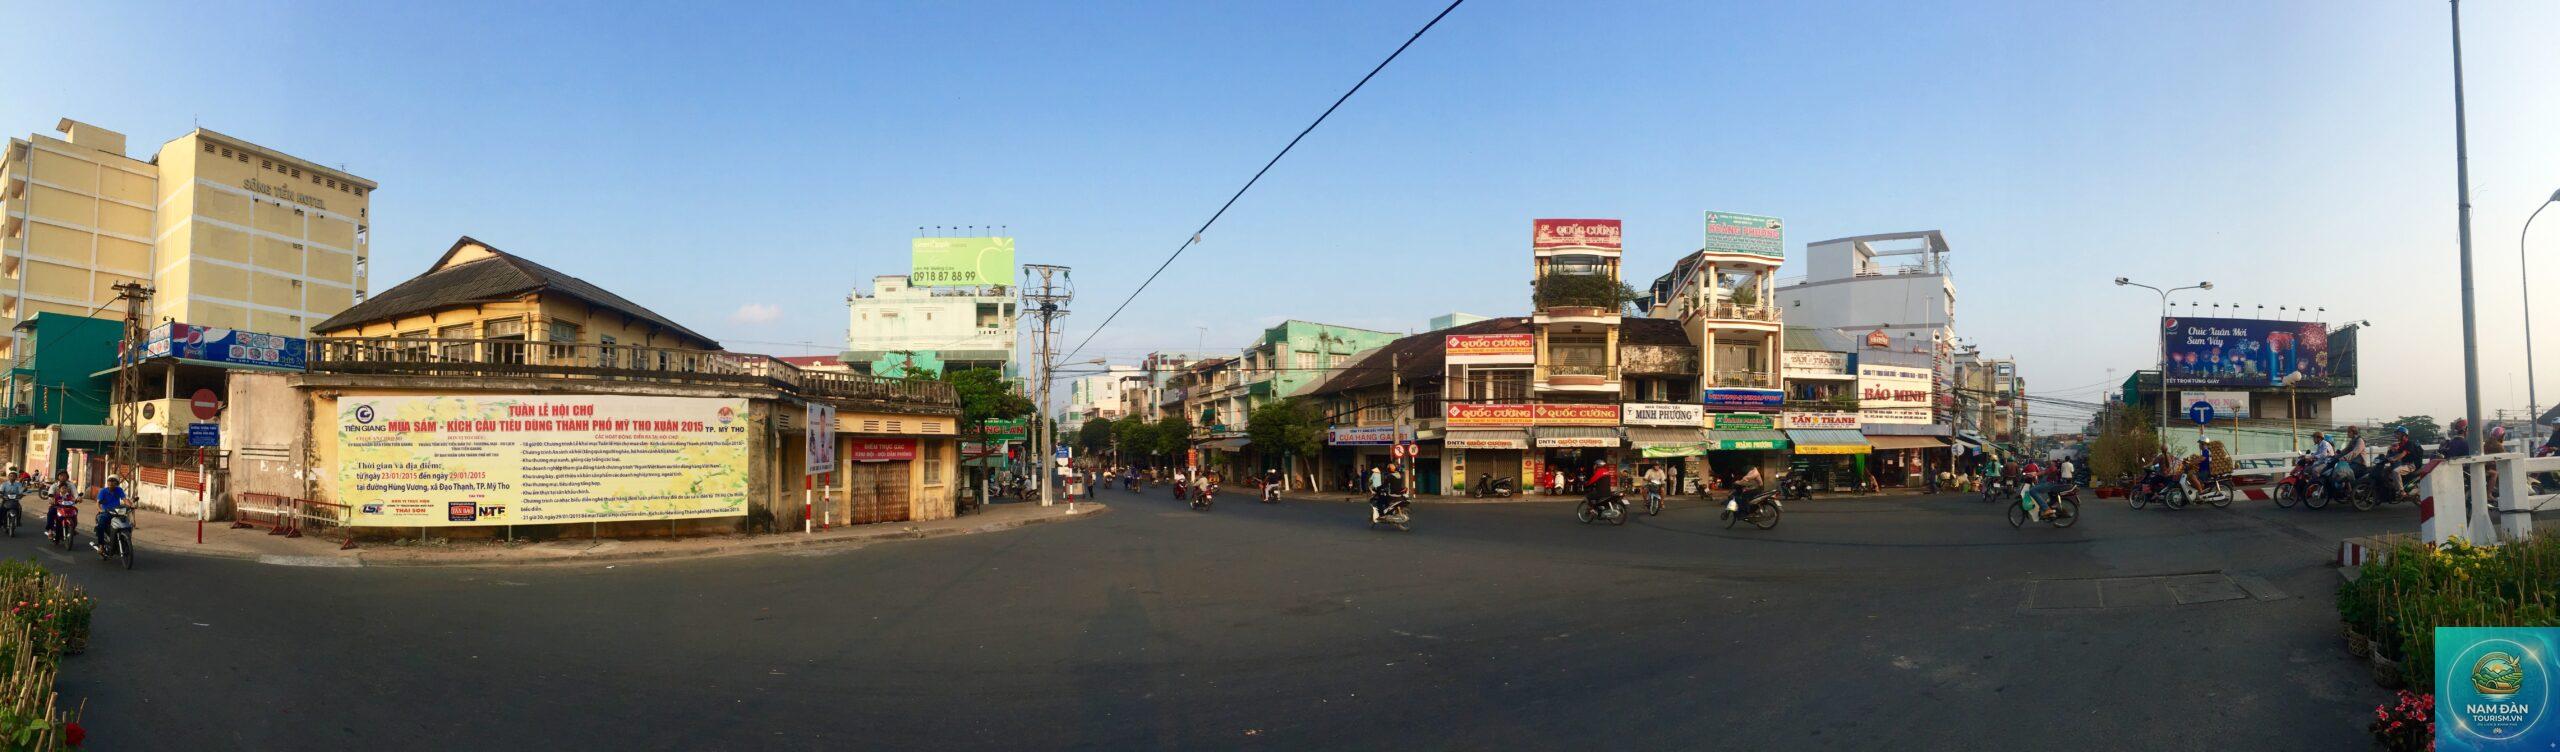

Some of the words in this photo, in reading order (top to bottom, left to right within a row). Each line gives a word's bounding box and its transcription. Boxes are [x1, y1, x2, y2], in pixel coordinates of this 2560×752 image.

[914, 271, 936, 281] 0918
[938, 271, 949, 281] 87
[952, 271, 962, 281] 88
[965, 271, 976, 281] 99
[1460, 338, 1490, 348] QUỐC
[1492, 338, 1529, 348] CƯỜNG
[2186, 336, 2205, 345] Sum
[1865, 383, 1891, 401] BẢO
[1894, 389, 1927, 402] MINH
[509, 403, 536, 417] TUẦN
[538, 403, 549, 417] LỄ
[552, 404, 570, 419] HỘI
[573, 404, 594, 418] CHỢ
[1462, 408, 1492, 418] QUỐC
[1493, 407, 1531, 418] CƯỜNG
[1547, 407, 1577, 419] QUỐC
[1579, 407, 1615, 418] CƯỜNG
[1635, 409, 1658, 420] MINH
[388, 421, 411, 433] MUA
[414, 418, 437, 433] SẮM
[447, 418, 473, 433] KÍCH
[475, 416, 497, 433] CẦU
[499, 419, 522, 432] TIÊU
[525, 419, 553, 432] DÙNG
[556, 418, 589, 432] THÀNH
[593, 416, 613, 432] PHỐ
[616, 418, 630, 432] MỸ
[633, 420, 652, 432] THO
[654, 419, 679, 432] XUÂN
[681, 421, 704, 432] 2015
[719, 425, 729, 433] MỸ
[1380, 432, 1394, 441] GA
[357, 472, 365, 480] từ
[365, 473, 381, 481] ngày
[382, 472, 417, 480] 23/01/2015
[432, 472, 449, 481] ngày
[450, 471, 486, 479] 29/01/2015
[479, 506, 506, 517] NTF
